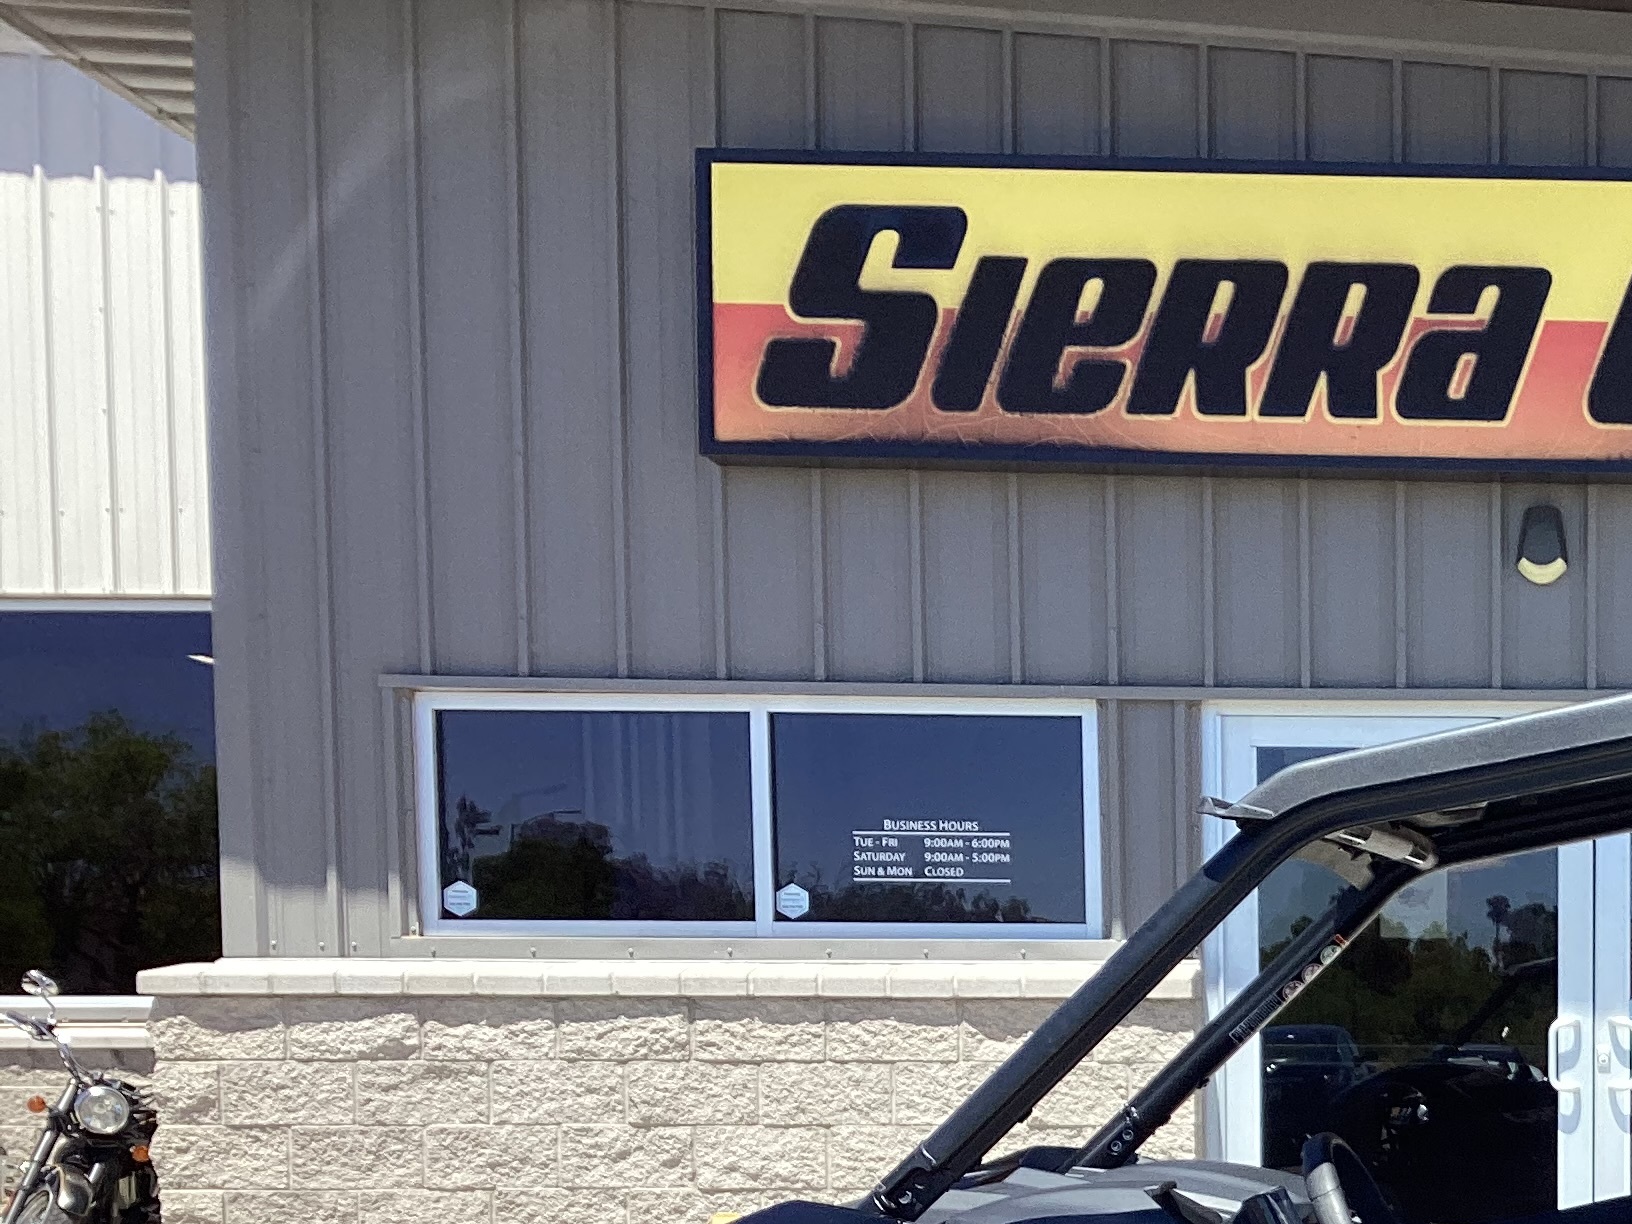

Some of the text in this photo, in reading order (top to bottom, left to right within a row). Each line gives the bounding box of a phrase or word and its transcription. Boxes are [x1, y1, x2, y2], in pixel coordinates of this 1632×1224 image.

[924, 838, 963, 848] 9:00AM
[924, 852, 964, 862] 9:00AM
[971, 853, 1010, 862] 5:00PM
